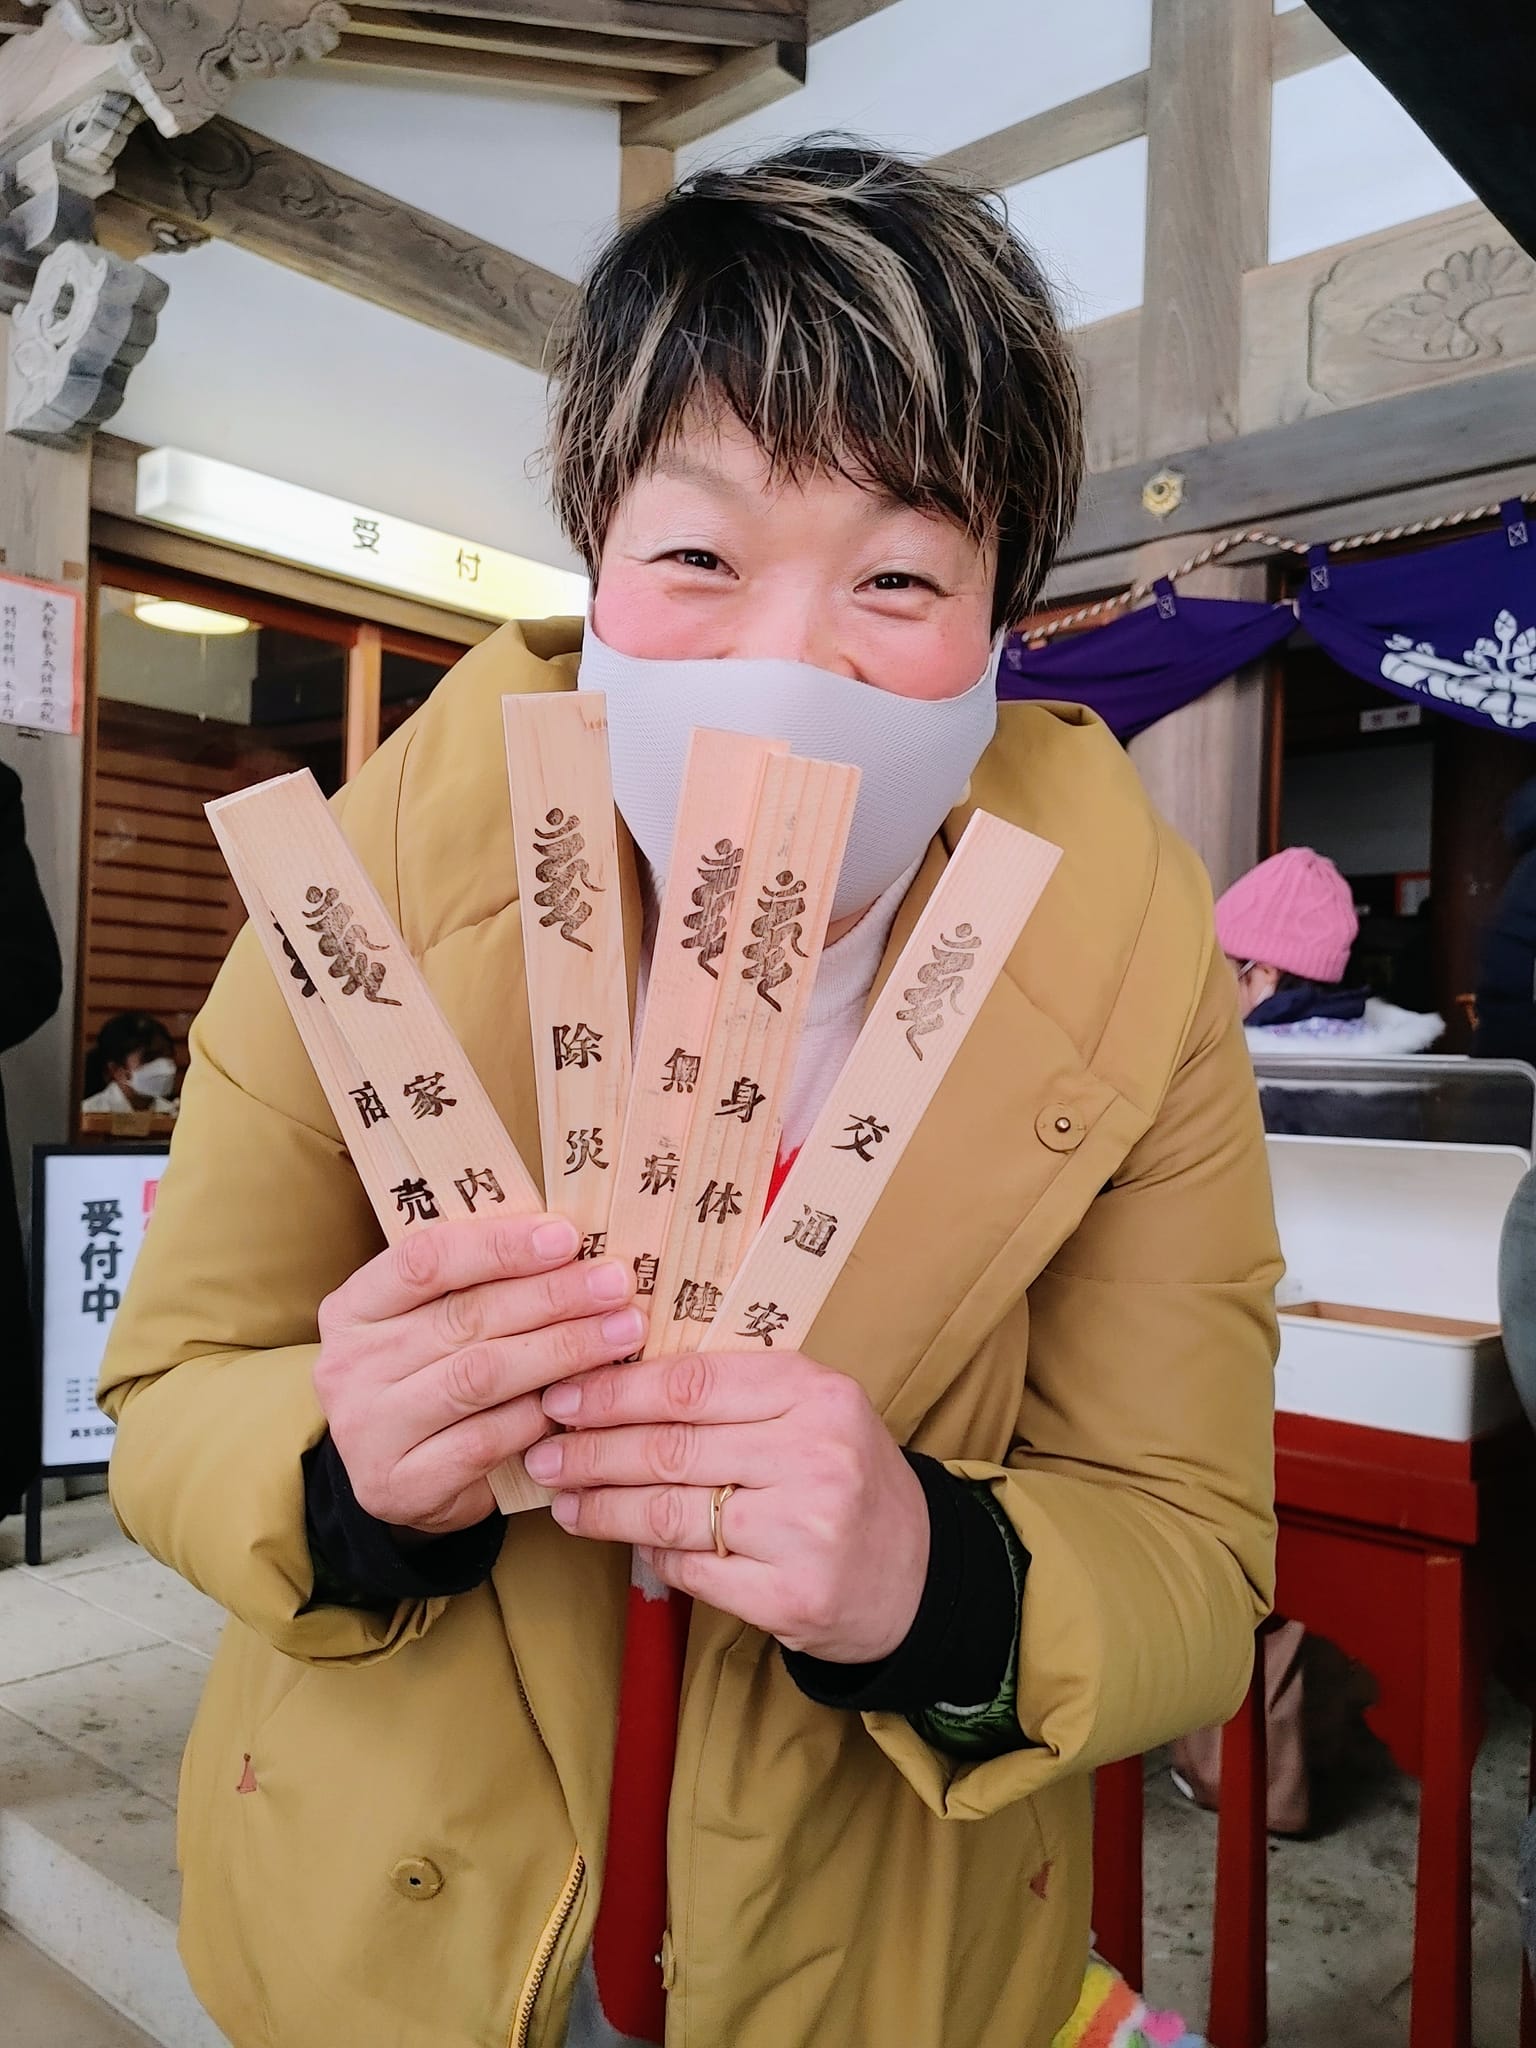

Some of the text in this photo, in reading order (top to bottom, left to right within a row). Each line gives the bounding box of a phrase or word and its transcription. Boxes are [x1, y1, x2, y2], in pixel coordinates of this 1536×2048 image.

[353, 517, 481, 582] 受付
[348, 1081, 440, 1226] 商売
[403, 1071, 506, 1213] 家内
[672, 1076, 766, 1323] 身体健
[80, 1199, 123, 1322] 受付中
[735, 1113, 891, 1348] 交通安
